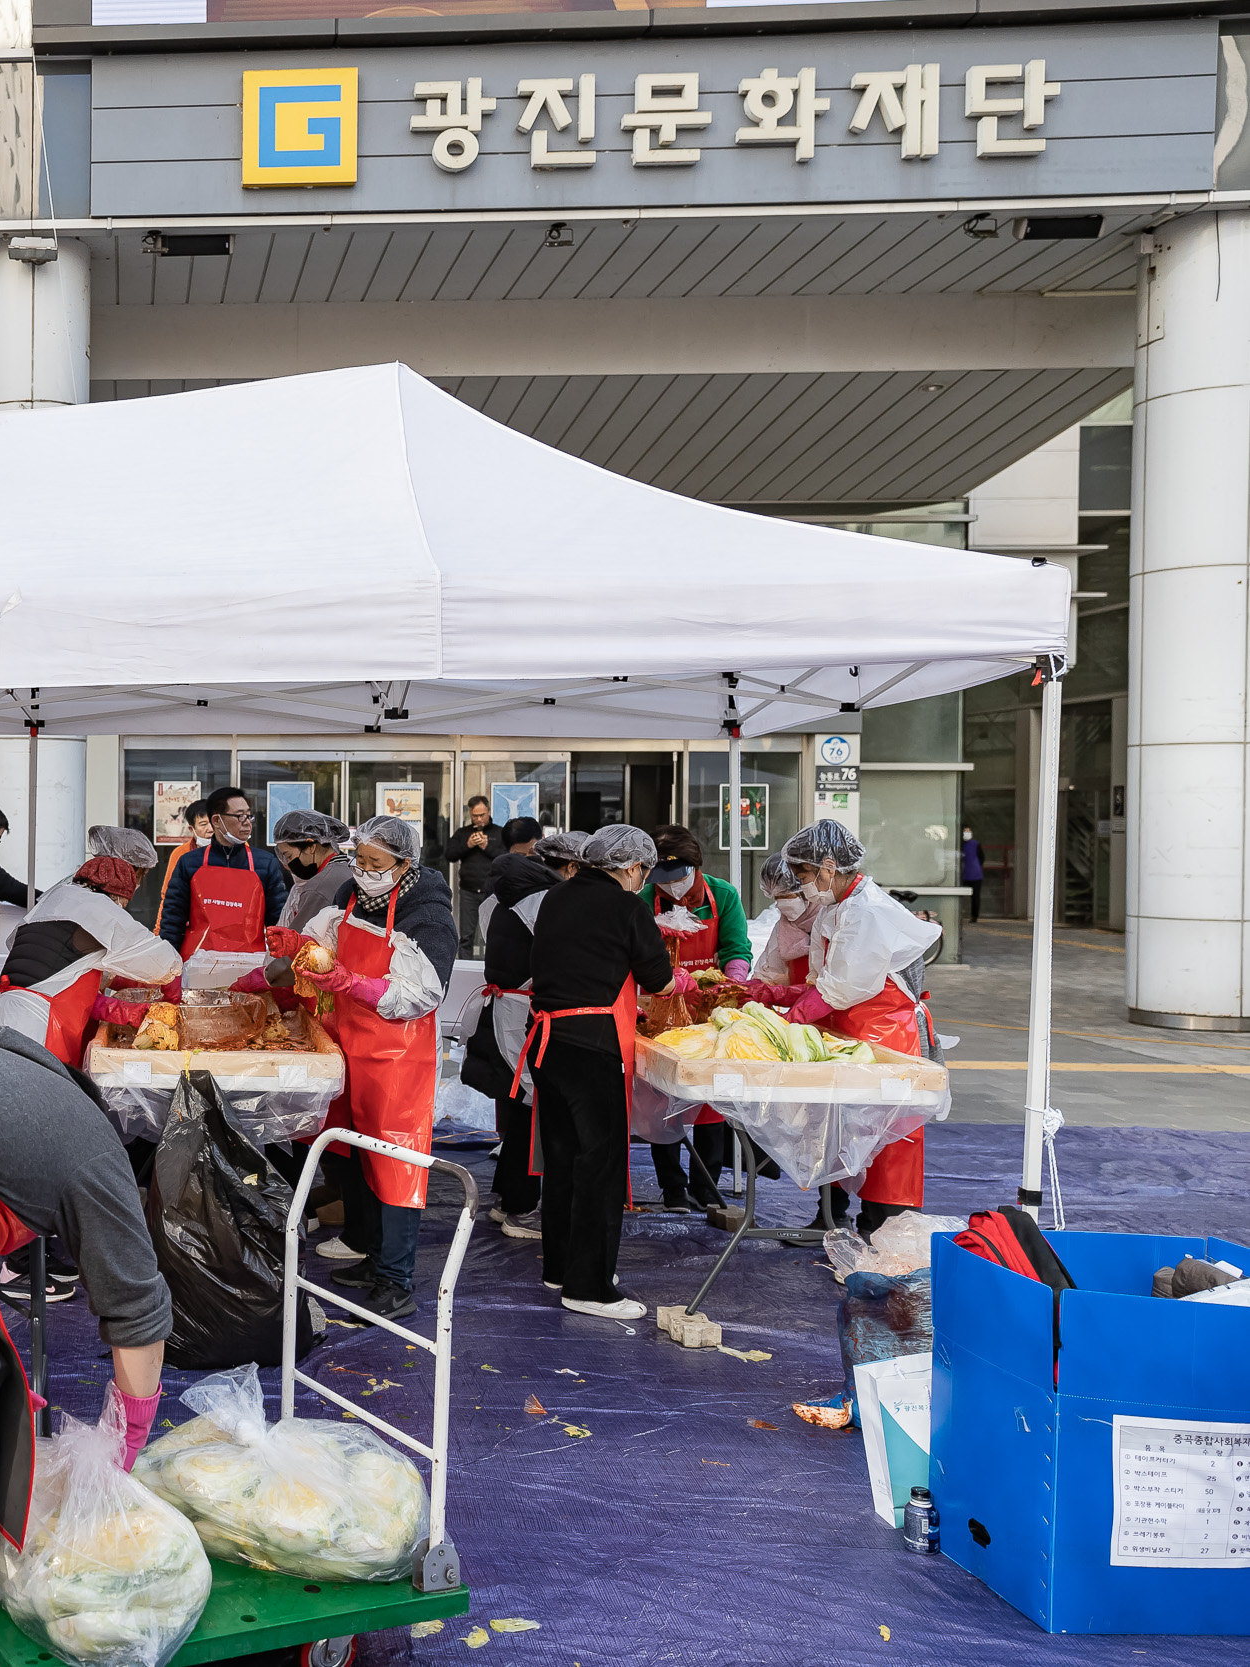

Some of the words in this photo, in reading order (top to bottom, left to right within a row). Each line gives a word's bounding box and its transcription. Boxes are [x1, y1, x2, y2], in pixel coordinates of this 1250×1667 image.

[410, 58, 1061, 174] 광진문화재단
[830, 748, 843, 756] 76
[841, 767, 857, 781] 76
[1210, 1460, 1215, 1468] 2
